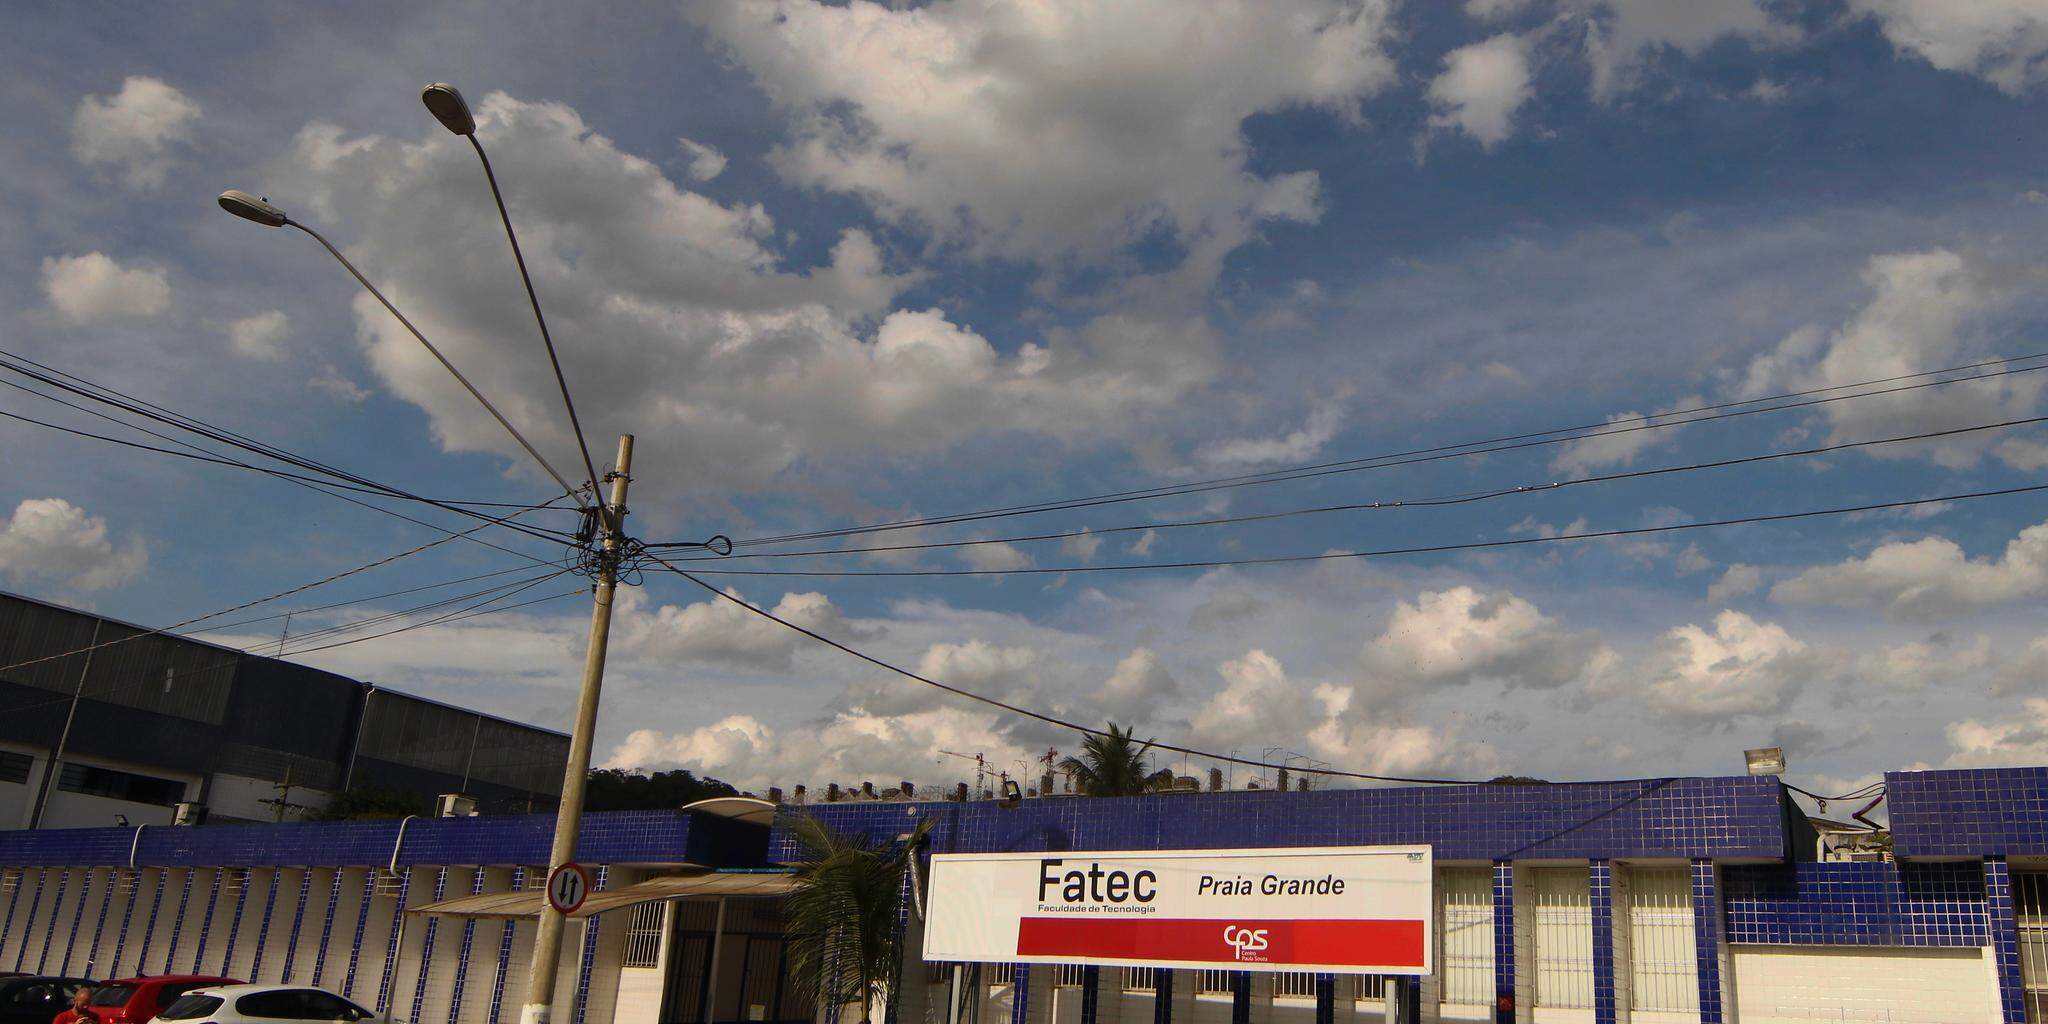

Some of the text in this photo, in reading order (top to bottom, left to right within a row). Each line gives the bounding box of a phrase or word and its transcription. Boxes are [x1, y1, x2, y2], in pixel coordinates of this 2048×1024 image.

[1038, 858, 1157, 903] Fatec
[1198, 874, 1345, 896] Praia Grande
[1038, 905, 1087, 913] Faculdade
[1088, 905, 1100, 913] de
